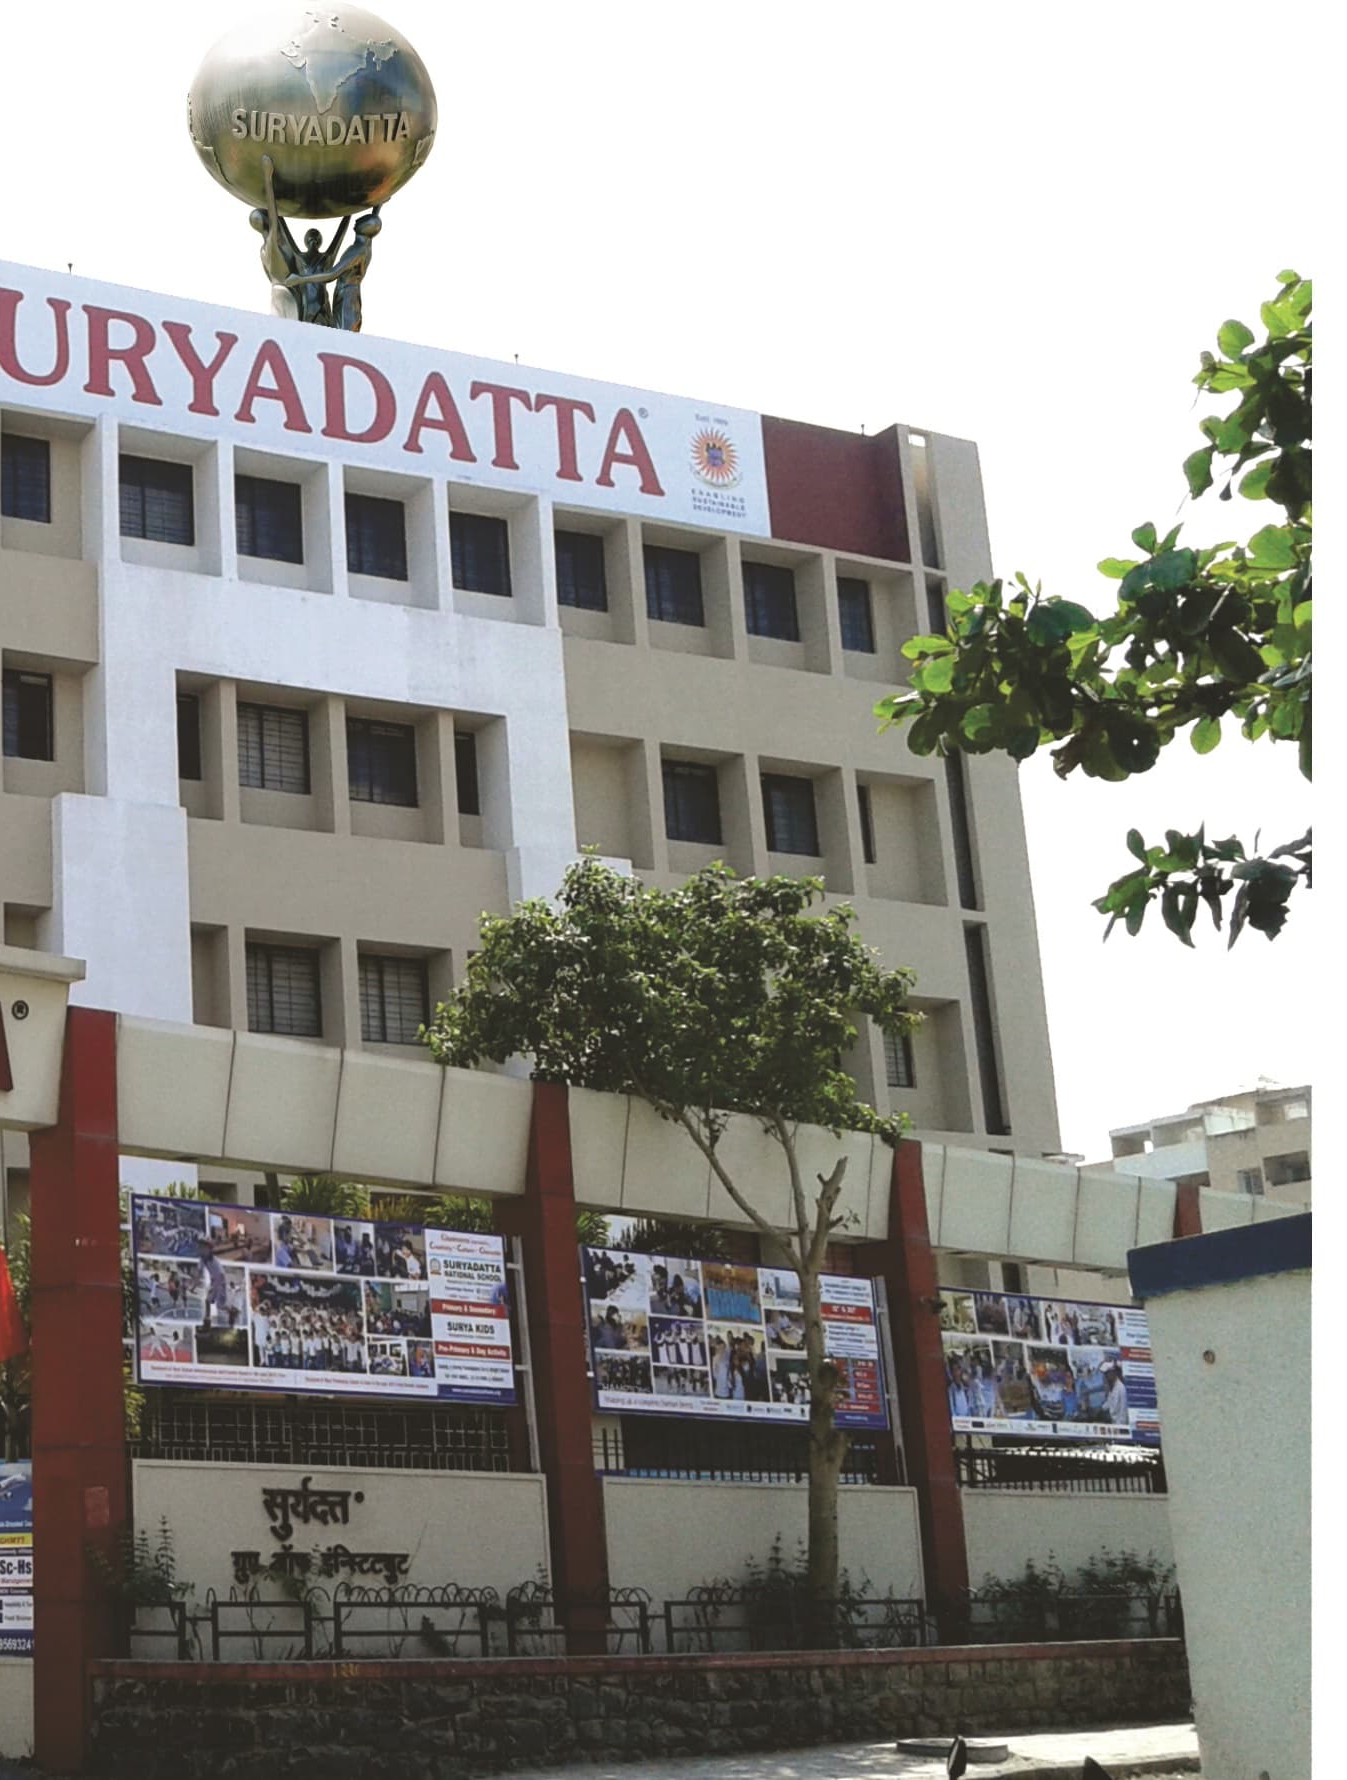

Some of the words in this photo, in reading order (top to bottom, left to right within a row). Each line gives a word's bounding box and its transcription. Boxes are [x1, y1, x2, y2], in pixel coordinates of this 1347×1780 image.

[231, 107, 411, 146] SURYADATTA
[443, 1259, 502, 1274] SURYADATTA
[444, 1270, 475, 1281] NATIONAL
[476, 1273, 502, 1283] SCHOOL
[447, 1321, 473, 1332] SURYA
[475, 1324, 495, 1334] KIDS
